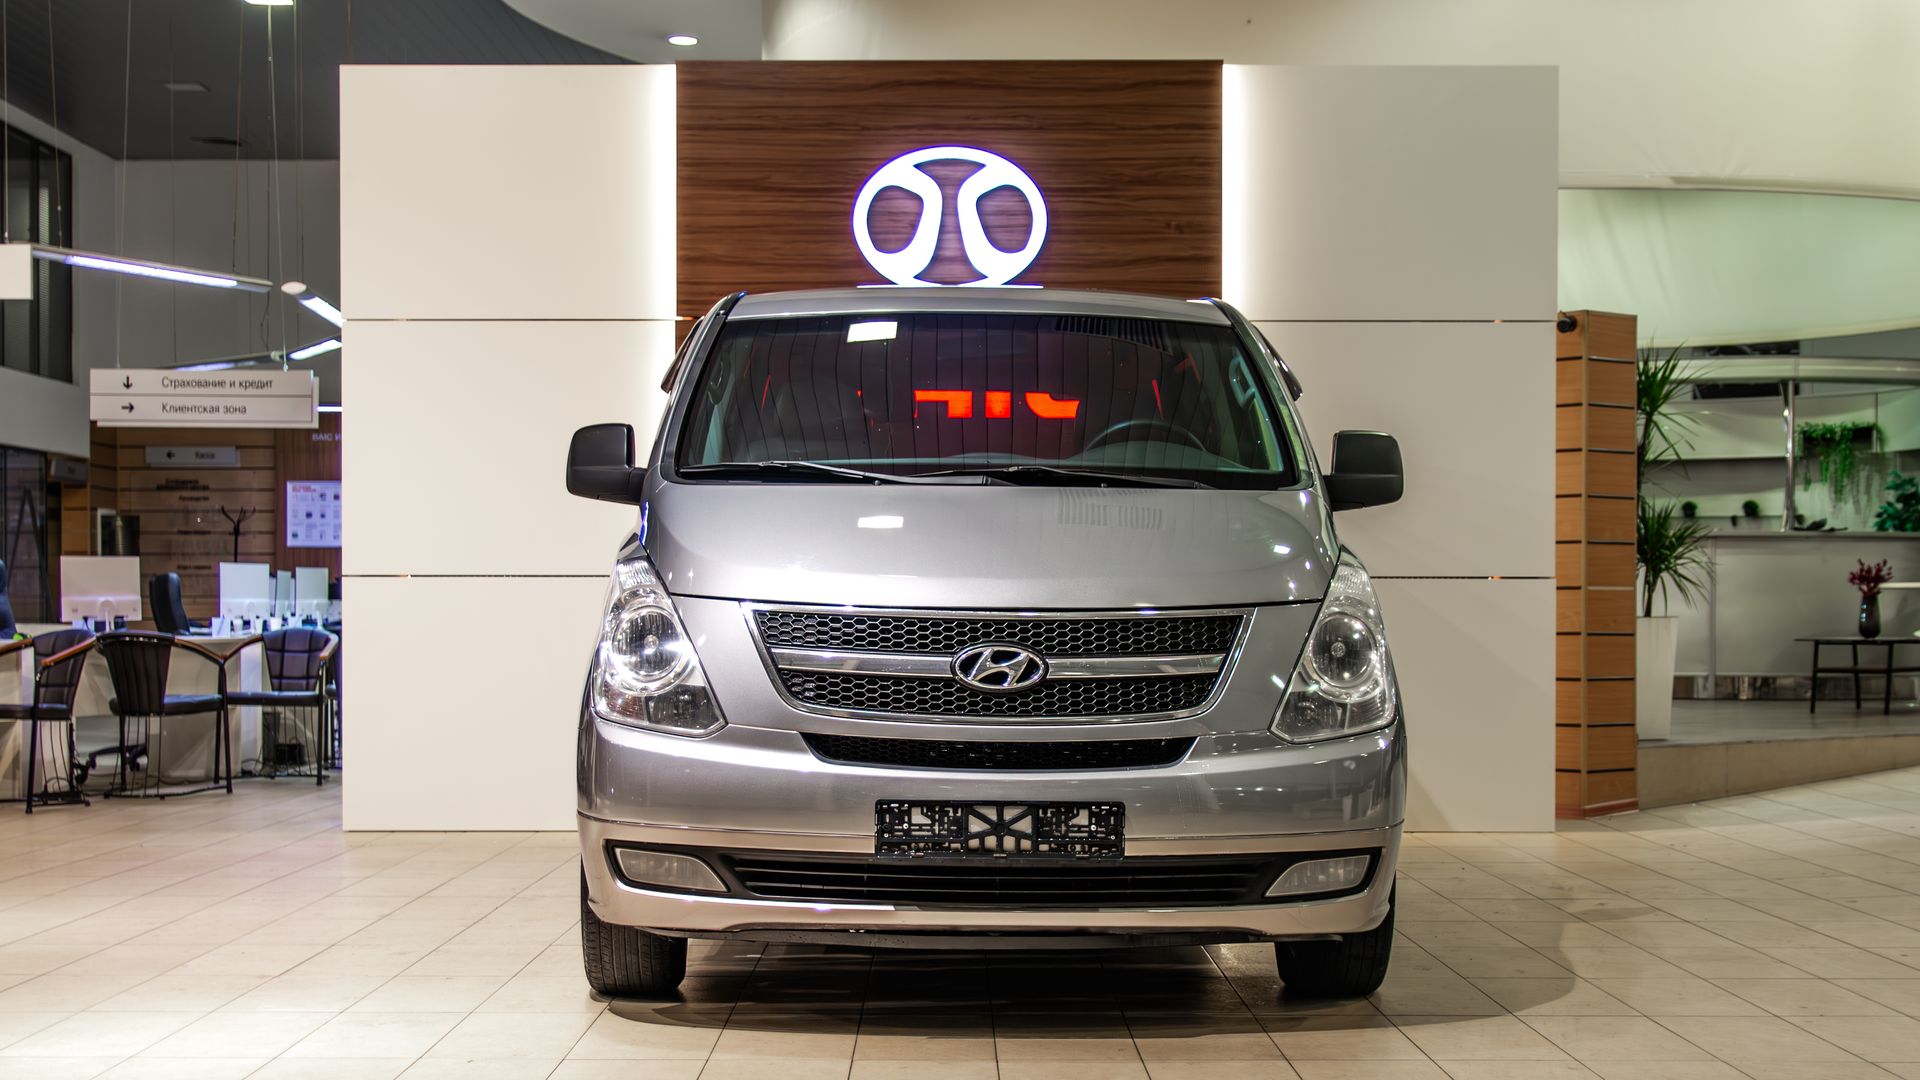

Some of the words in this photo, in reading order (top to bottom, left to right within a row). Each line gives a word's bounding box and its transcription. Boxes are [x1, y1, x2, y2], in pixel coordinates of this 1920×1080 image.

[161, 376, 226, 390] Страхование
[229, 379, 236, 389] и
[239, 379, 273, 390] кредит
[161, 402, 220, 415] Клиентская
[223, 404, 247, 415] зона
